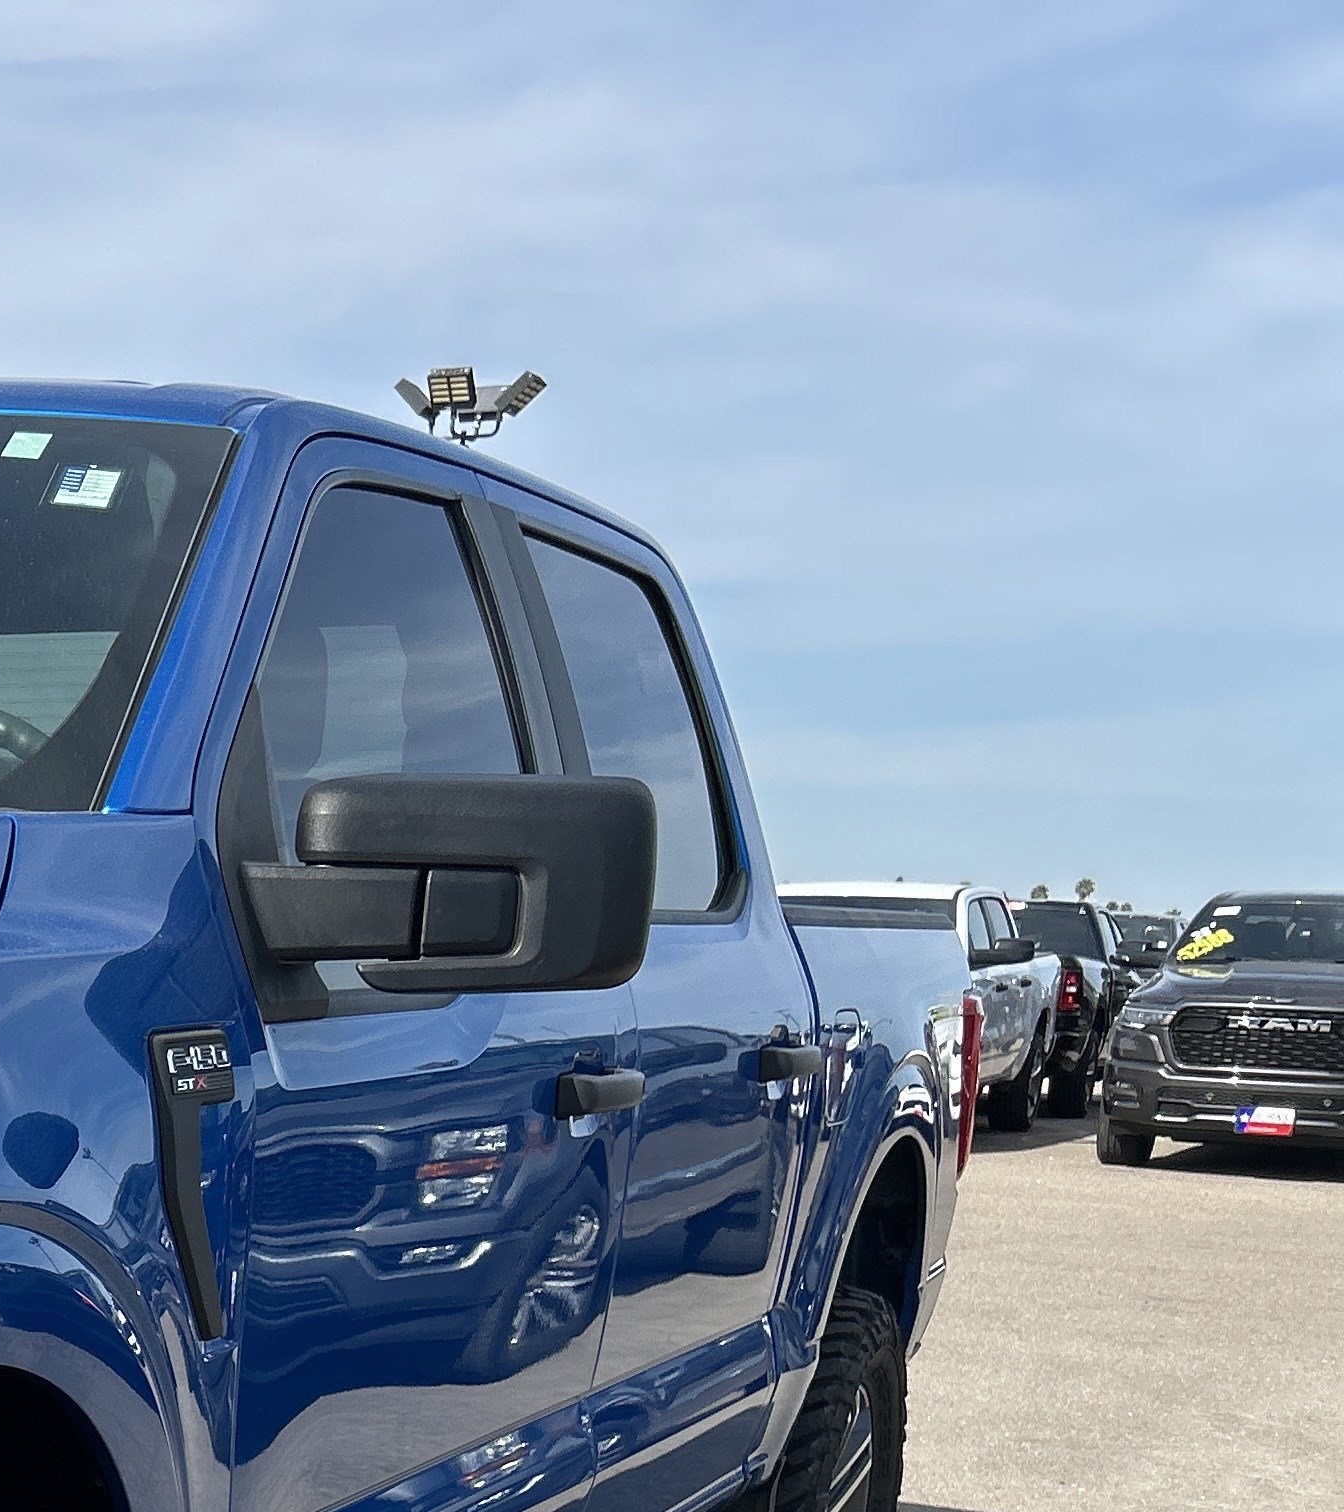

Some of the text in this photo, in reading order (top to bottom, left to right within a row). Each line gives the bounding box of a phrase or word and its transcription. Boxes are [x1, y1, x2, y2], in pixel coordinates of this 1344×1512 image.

[1227, 1015, 1332, 1033] RAM
[166, 1044, 232, 1074] F-150
[177, 1075, 208, 1092] STX
